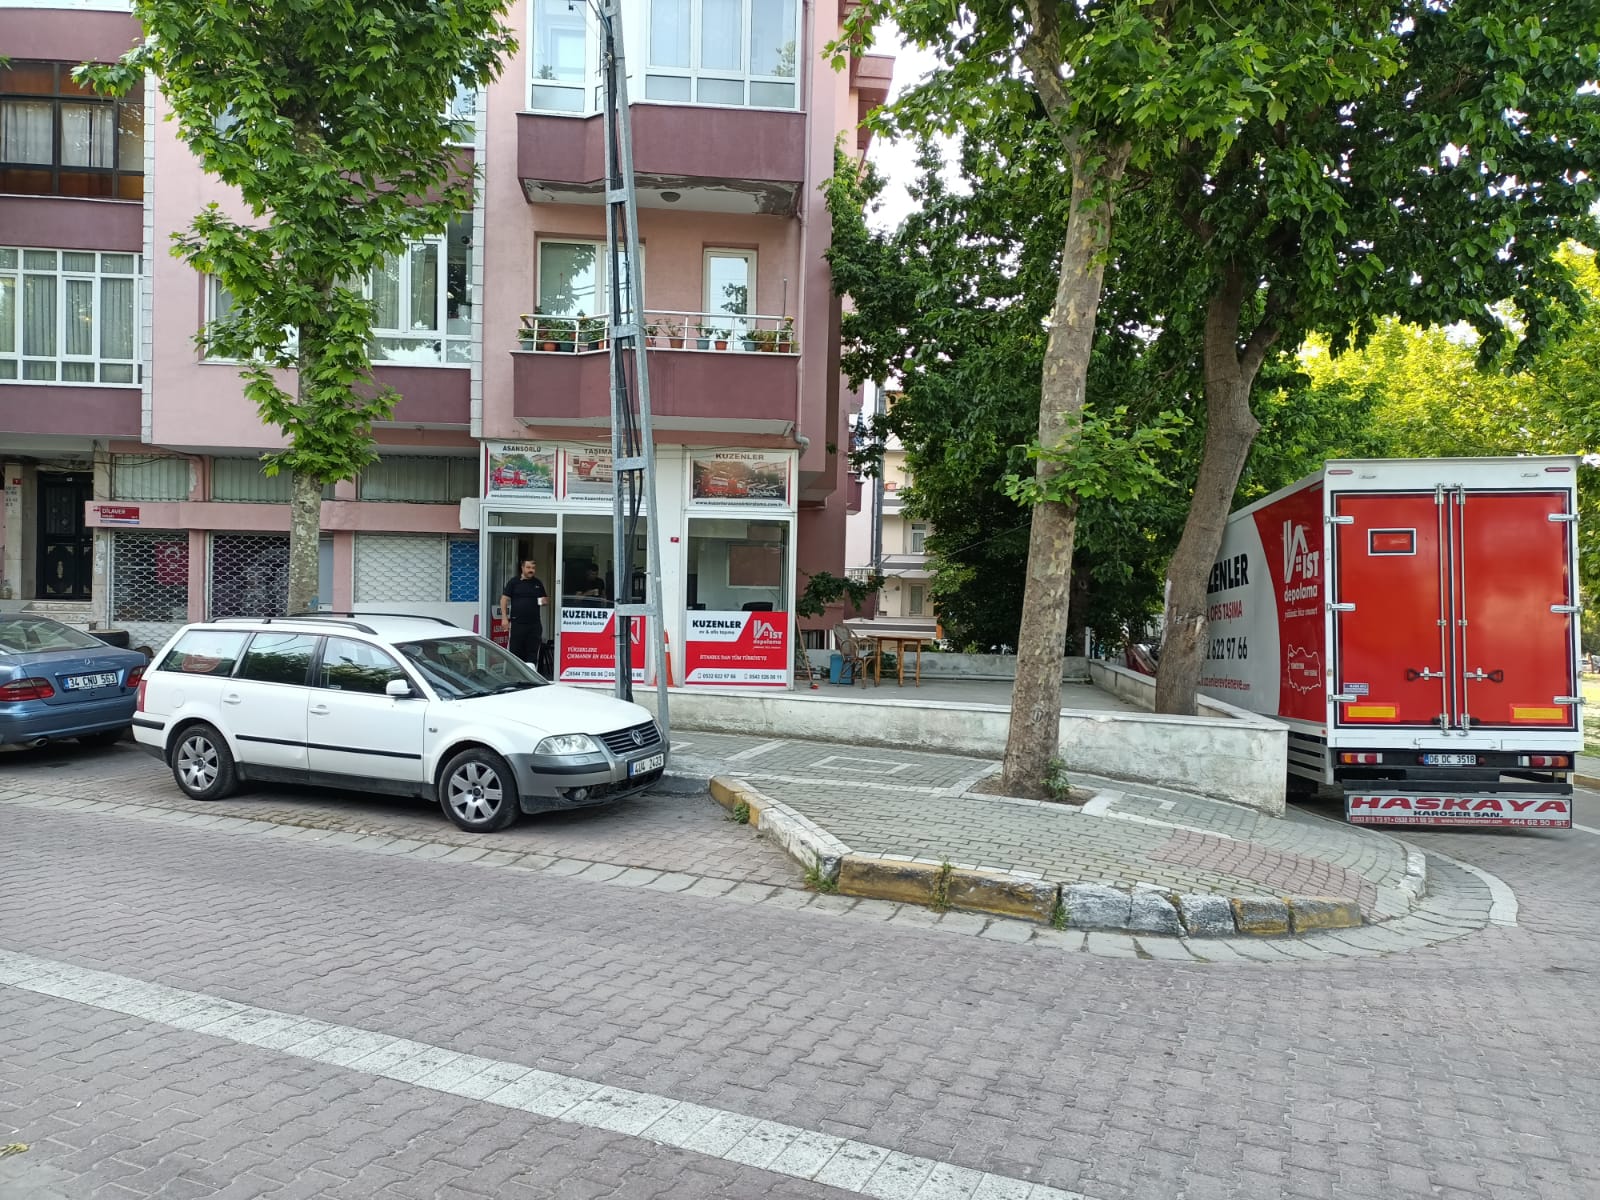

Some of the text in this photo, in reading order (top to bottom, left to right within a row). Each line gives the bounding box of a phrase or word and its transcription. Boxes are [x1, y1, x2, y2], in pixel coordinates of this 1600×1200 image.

[1206, 553, 1249, 595] ZENLER
[1284, 583, 1318, 604] depolama
[562, 610, 608, 619] KUZENLER
[692, 620, 742, 628] KUZENLER
[1212, 638, 1224, 660] 622
[1226, 637, 1236, 660] 97
[1238, 636, 1248, 660] 66
[69, 678, 79, 688] 34
[1429, 755, 1439, 763] 06
[1456, 755, 1475, 764] 3518
[1351, 797, 1567, 812] HASKAYA
